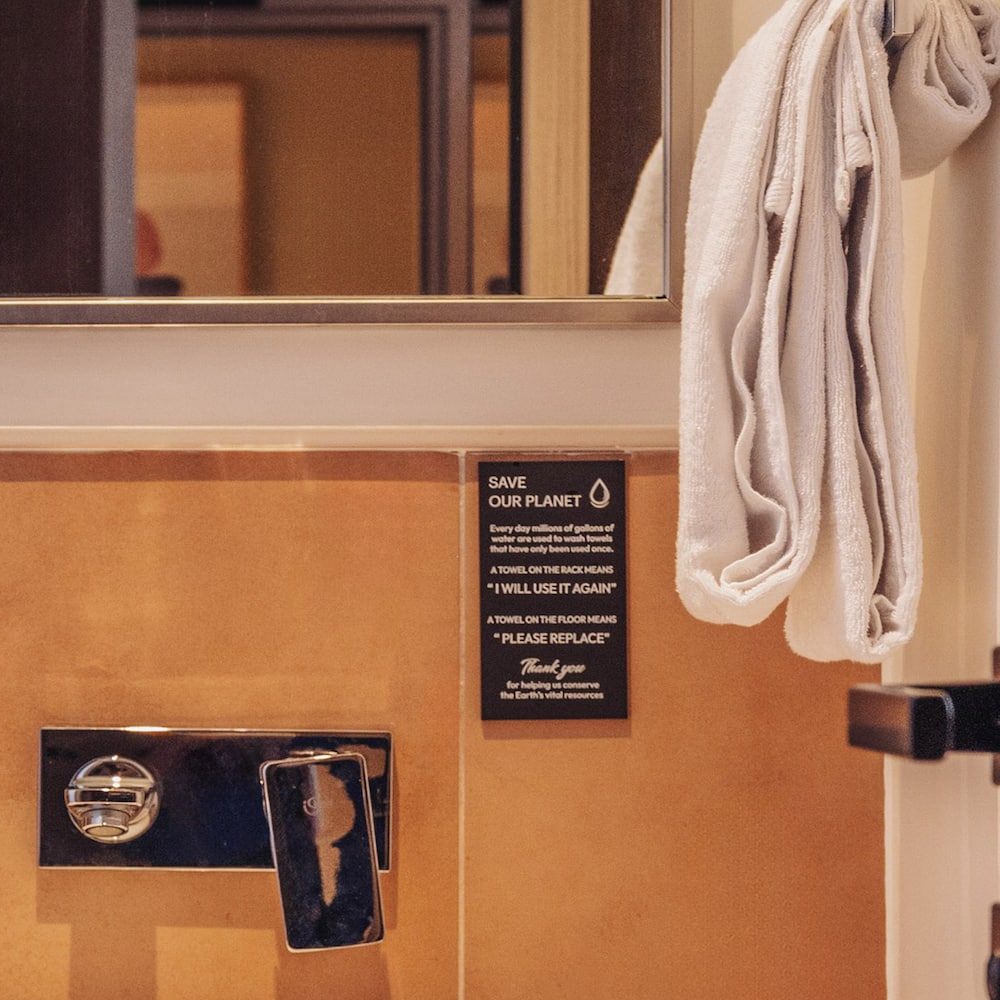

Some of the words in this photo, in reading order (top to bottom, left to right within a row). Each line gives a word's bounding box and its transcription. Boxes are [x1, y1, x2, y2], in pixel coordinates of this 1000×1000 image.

[488, 476, 527, 489] SAVE
[488, 495, 522, 507] OUR
[525, 495, 582, 507] PLANET
[489, 524, 513, 534] Every
[515, 524, 530, 534] day
[532, 524, 562, 532] millions
[564, 524, 573, 532] of
[574, 524, 603, 534] gallons
[605, 524, 615, 532] of
[532, 534, 551, 542] used
[564, 534, 585, 542] wash
[586, 534, 613, 542] towels
[490, 545, 507, 553] that
[509, 545, 529, 553] have
[530, 545, 548, 554] only
[549, 545, 570, 553] been
[571, 545, 590, 553] used
[490, 566, 498, 574] A
[498, 566, 528, 574] TOWEL
[528, 566, 543, 574] ON
[543, 566, 560, 574] THE
[561, 566, 583, 574] RACK
[584, 566, 614, 574] MEANS
[501, 583, 532, 594] WILL
[533, 583, 558, 594] USE
[559, 583, 571, 594] IT
[487, 616, 495, 624] A
[495, 616, 525, 624] TOWEL
[525, 616, 540, 624] ON
[540, 616, 557, 624] THE
[558, 616, 587, 624] FLOOR
[587, 615, 617, 624] MEANS
[520, 658, 560, 675] Thank
[555, 663, 586, 680] you
[506, 681, 520, 689] for
[521, 681, 551, 690] helping
